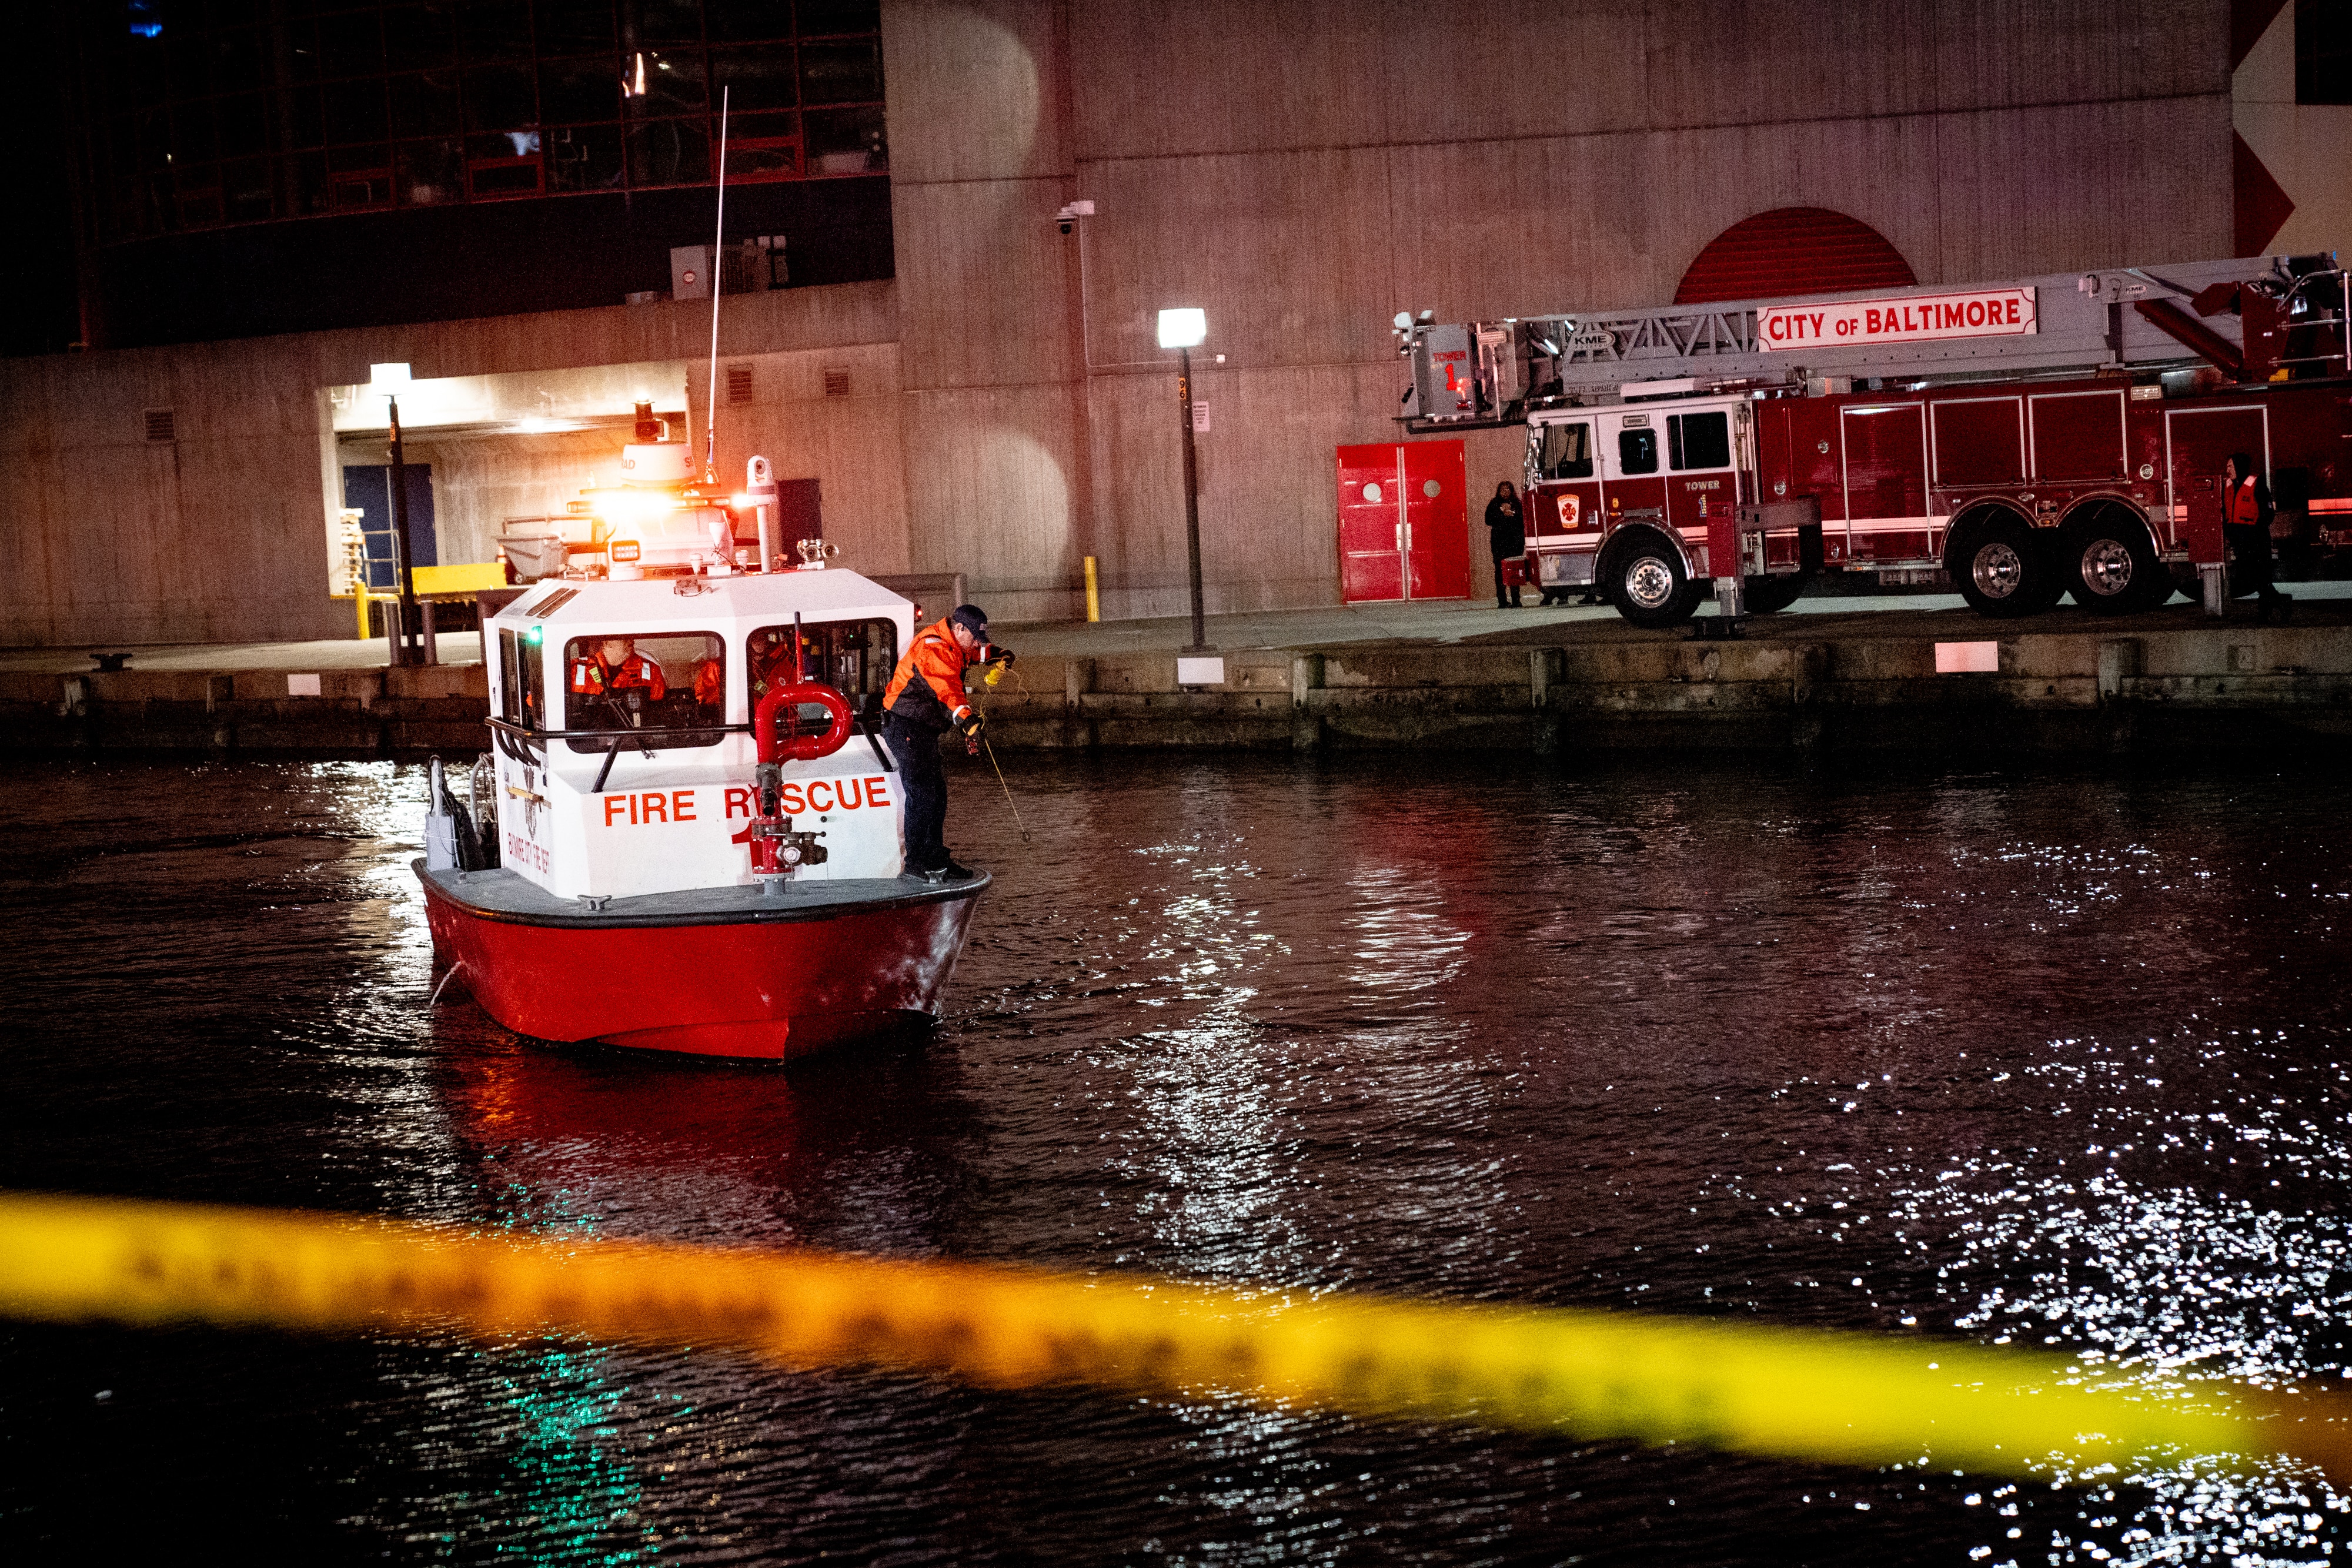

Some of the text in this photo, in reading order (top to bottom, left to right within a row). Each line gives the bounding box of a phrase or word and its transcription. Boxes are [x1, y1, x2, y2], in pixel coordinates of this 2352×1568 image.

[1769, 298, 2020, 341] CITY OF BALTIMORE
[1575, 335, 1606, 345] KME
[1433, 350, 1466, 362] TOWER
[1445, 363, 1457, 391] 1
[1685, 480, 1720, 492] TOWER
[604, 776, 891, 827] FIRE RSCUE
